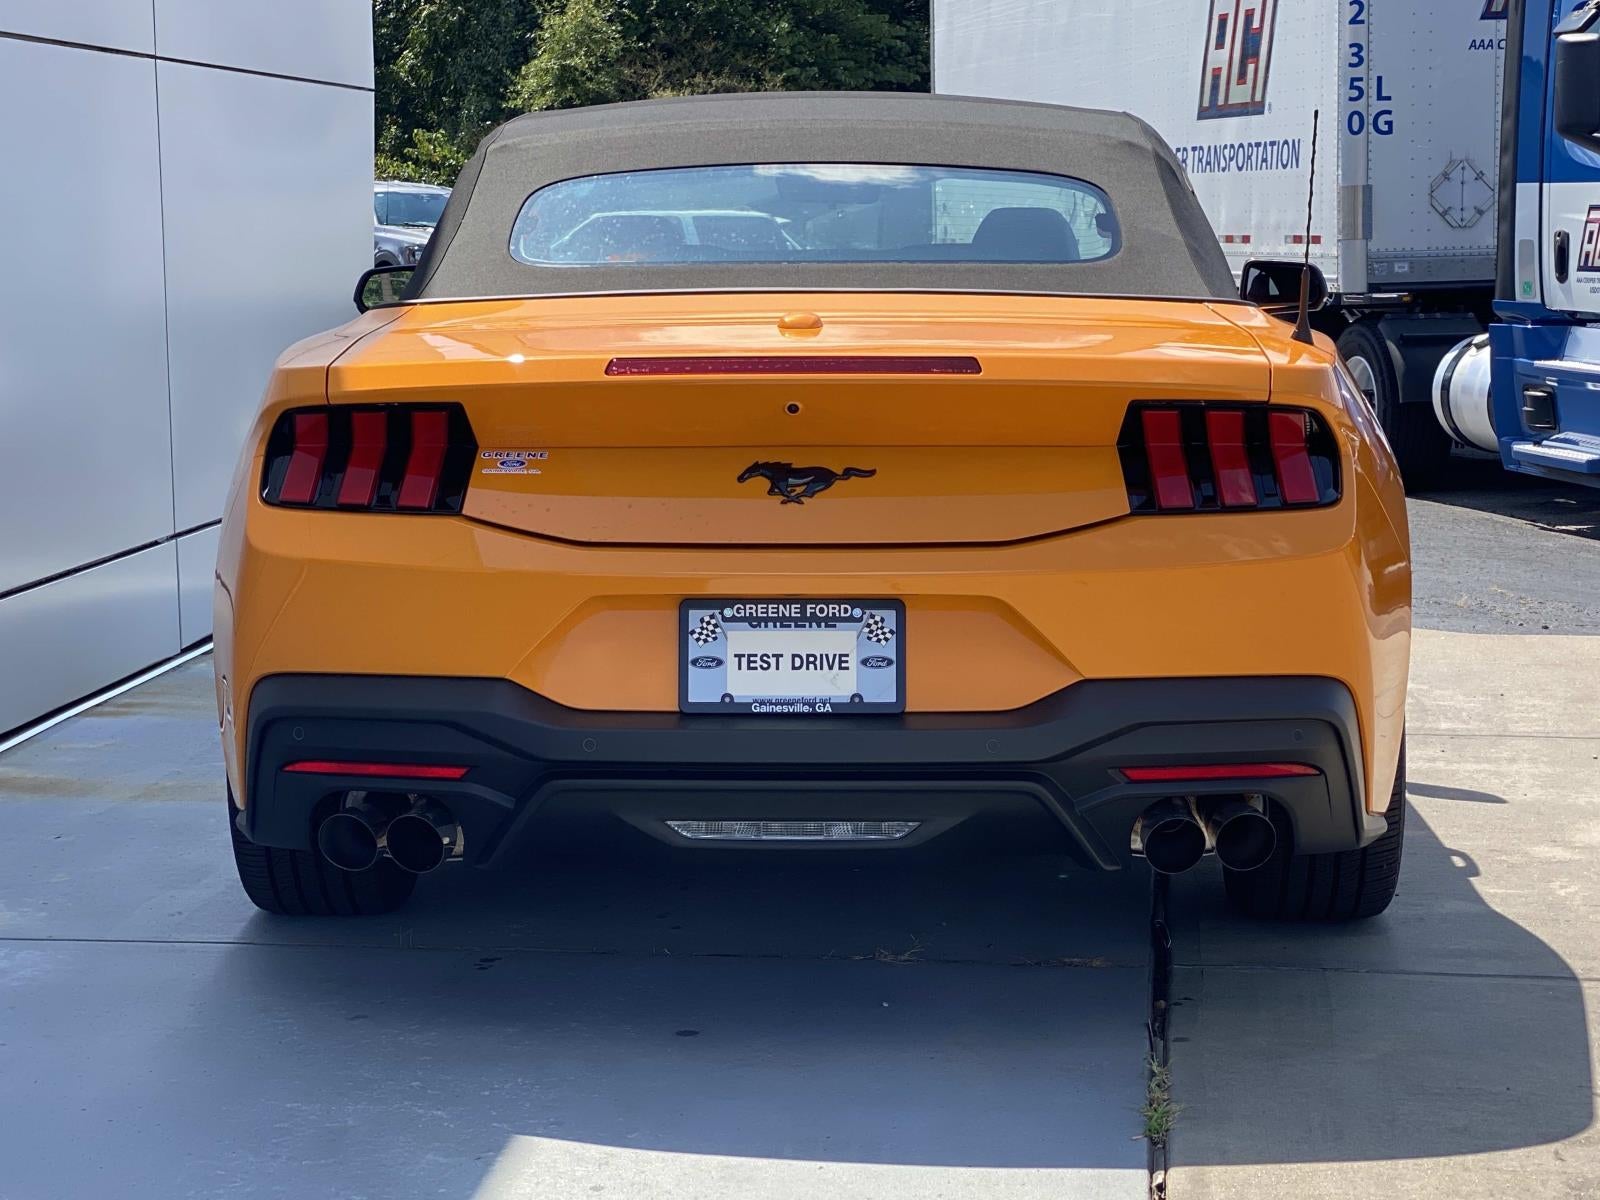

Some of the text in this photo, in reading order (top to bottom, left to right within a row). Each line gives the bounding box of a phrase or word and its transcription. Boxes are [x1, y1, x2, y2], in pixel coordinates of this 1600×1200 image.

[1468, 39, 1494, 50] AAA
[1191, 138, 1301, 174] TRANSPORTATION
[481, 451, 548, 459] GREENE
[733, 604, 852, 618] GREENE FORD
[695, 657, 718, 668] Ford
[734, 653, 850, 671] TEST DRIVE
[865, 656, 888, 668] Ford
[751, 703, 832, 713] Gainesville, GA
